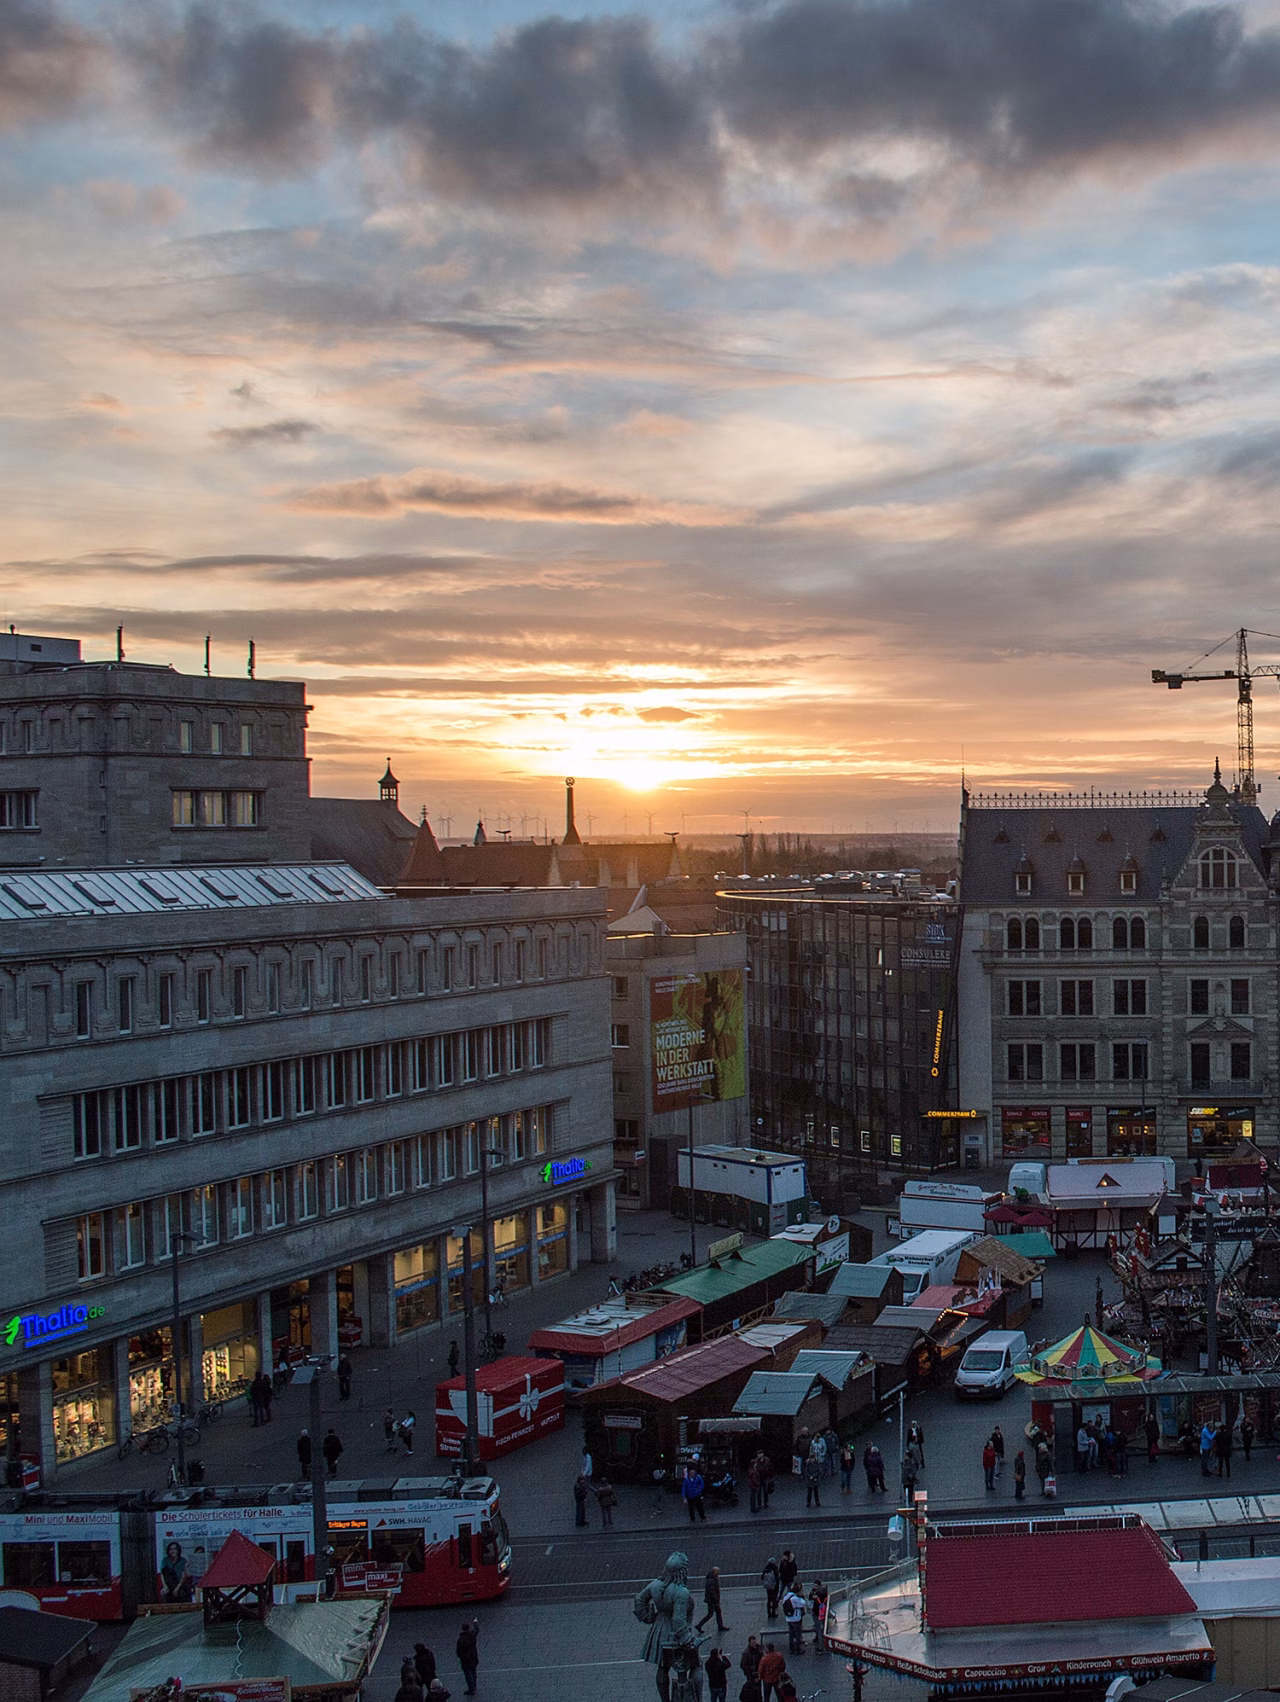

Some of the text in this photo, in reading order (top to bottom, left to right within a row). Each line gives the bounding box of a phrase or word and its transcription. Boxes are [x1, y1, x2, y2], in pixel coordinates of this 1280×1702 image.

[656, 1029, 706, 1051] MODERNE
[934, 1009, 944, 1064] COMMERZBANK
[656, 1047, 689, 1067] IN DER
[656, 1058, 715, 1082] WERKSTATT
[21, 1304, 105, 1340] Thalia.de
[25, 1513, 113, 1524] Mini und MaxiMobil
[161, 1507, 285, 1522] Die Schülertickets für Halle.
[408, 1516, 432, 1525] HAVAG
[834, 1641, 852, 1653] Kaffee
[861, 1649, 886, 1664] Espresso
[1131, 1652, 1200, 1666] Glühwein Amaretto
[913, 1665, 947, 1680] Schokolade
[1027, 1664, 1046, 1674] Grog
[1066, 1659, 1112, 1671] Kinderpunch
[964, 1668, 1007, 1678] Cappuccino
